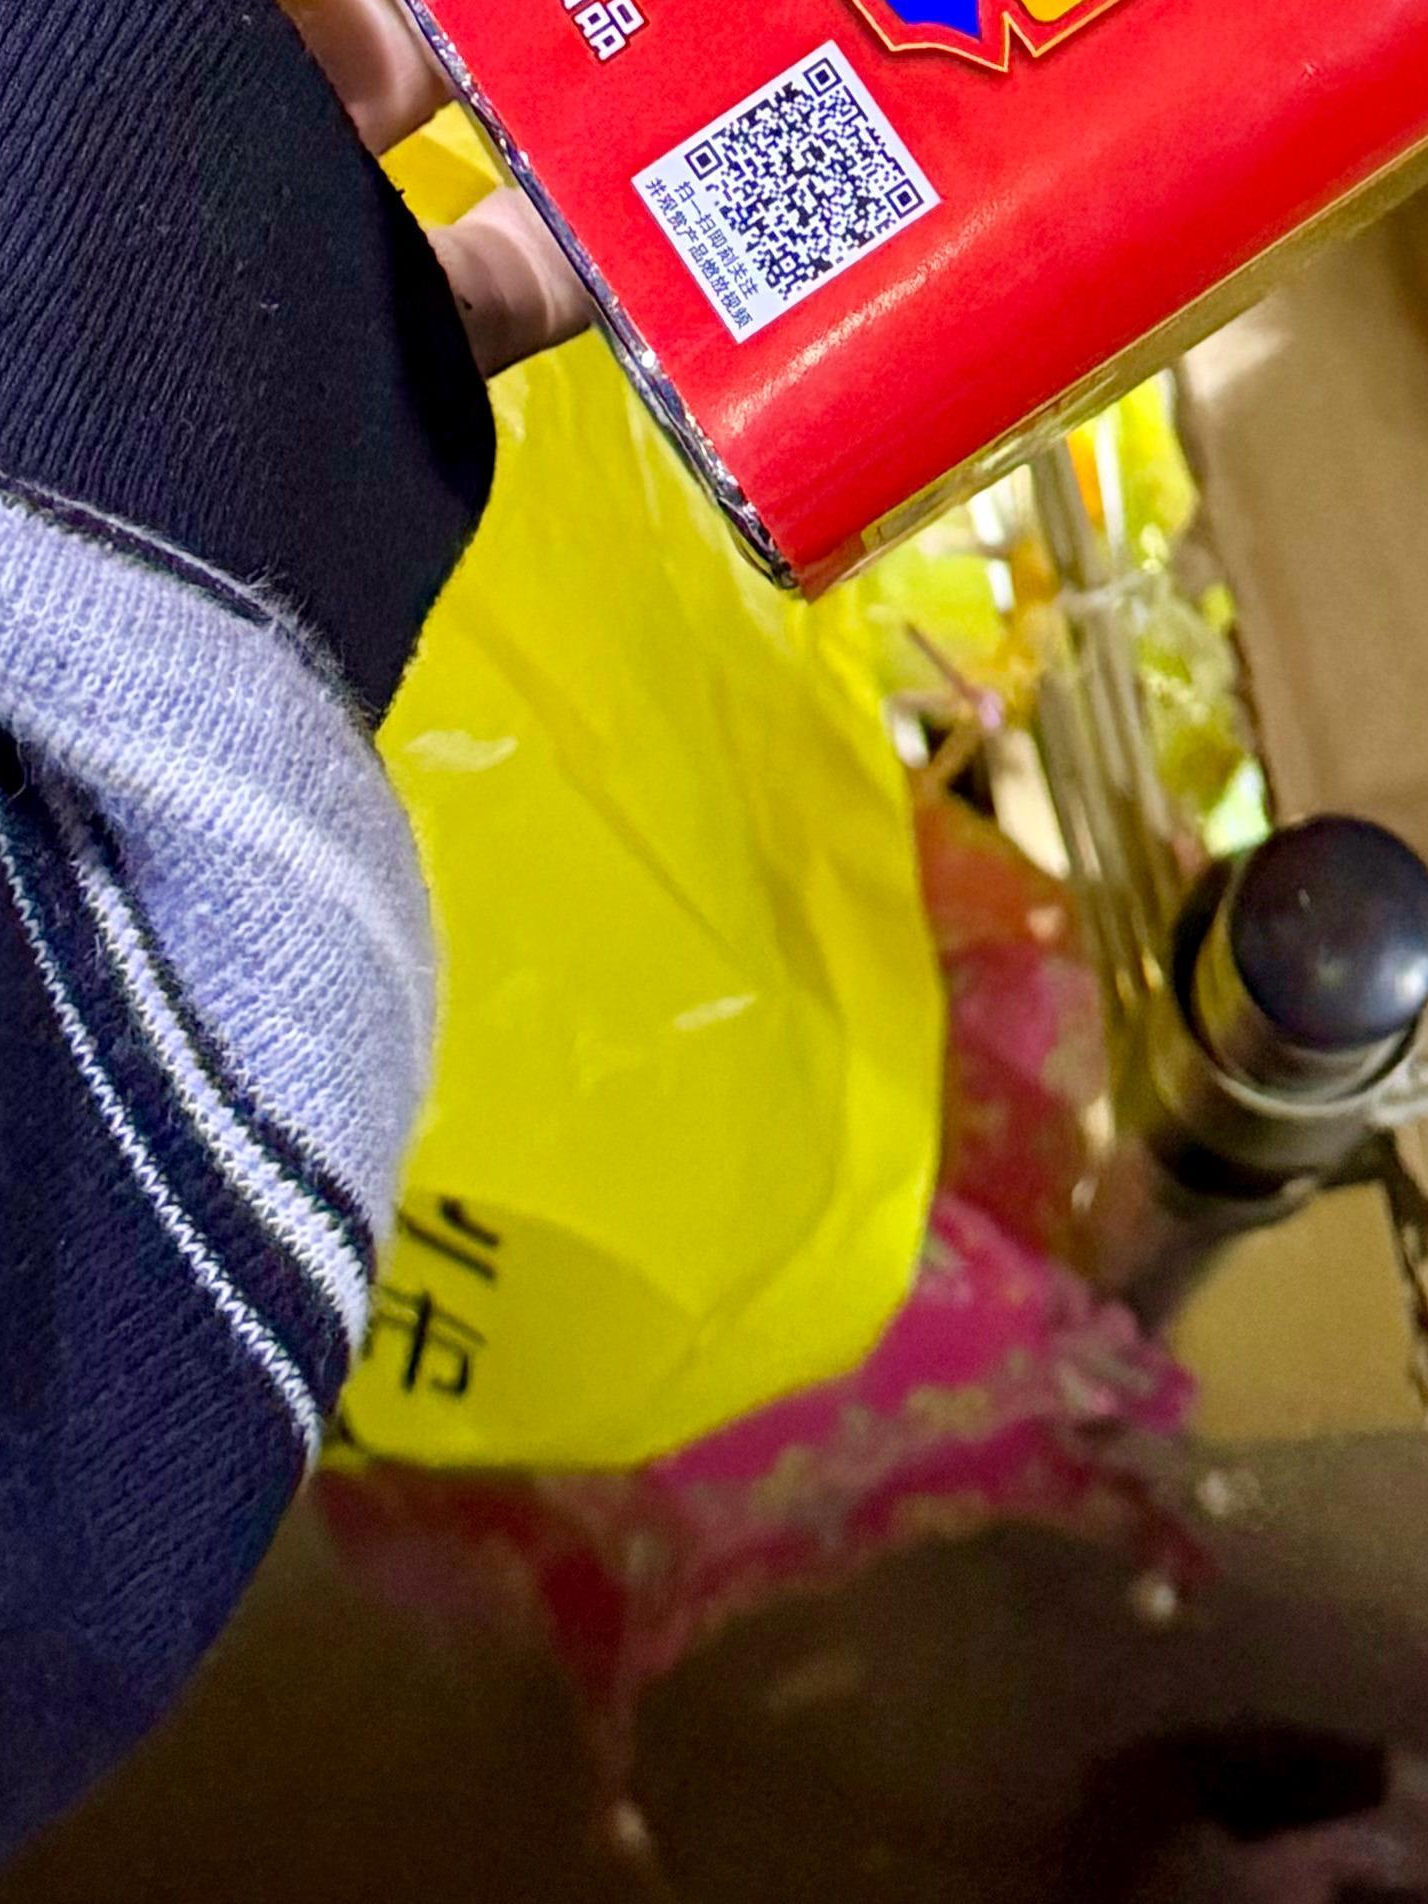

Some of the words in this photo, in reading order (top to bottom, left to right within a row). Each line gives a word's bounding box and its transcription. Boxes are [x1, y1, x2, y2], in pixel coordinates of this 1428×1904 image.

[644, 175, 754, 330] 并观赏产品燃放视频
[672, 179, 760, 299] 扫一扫即刻关注
